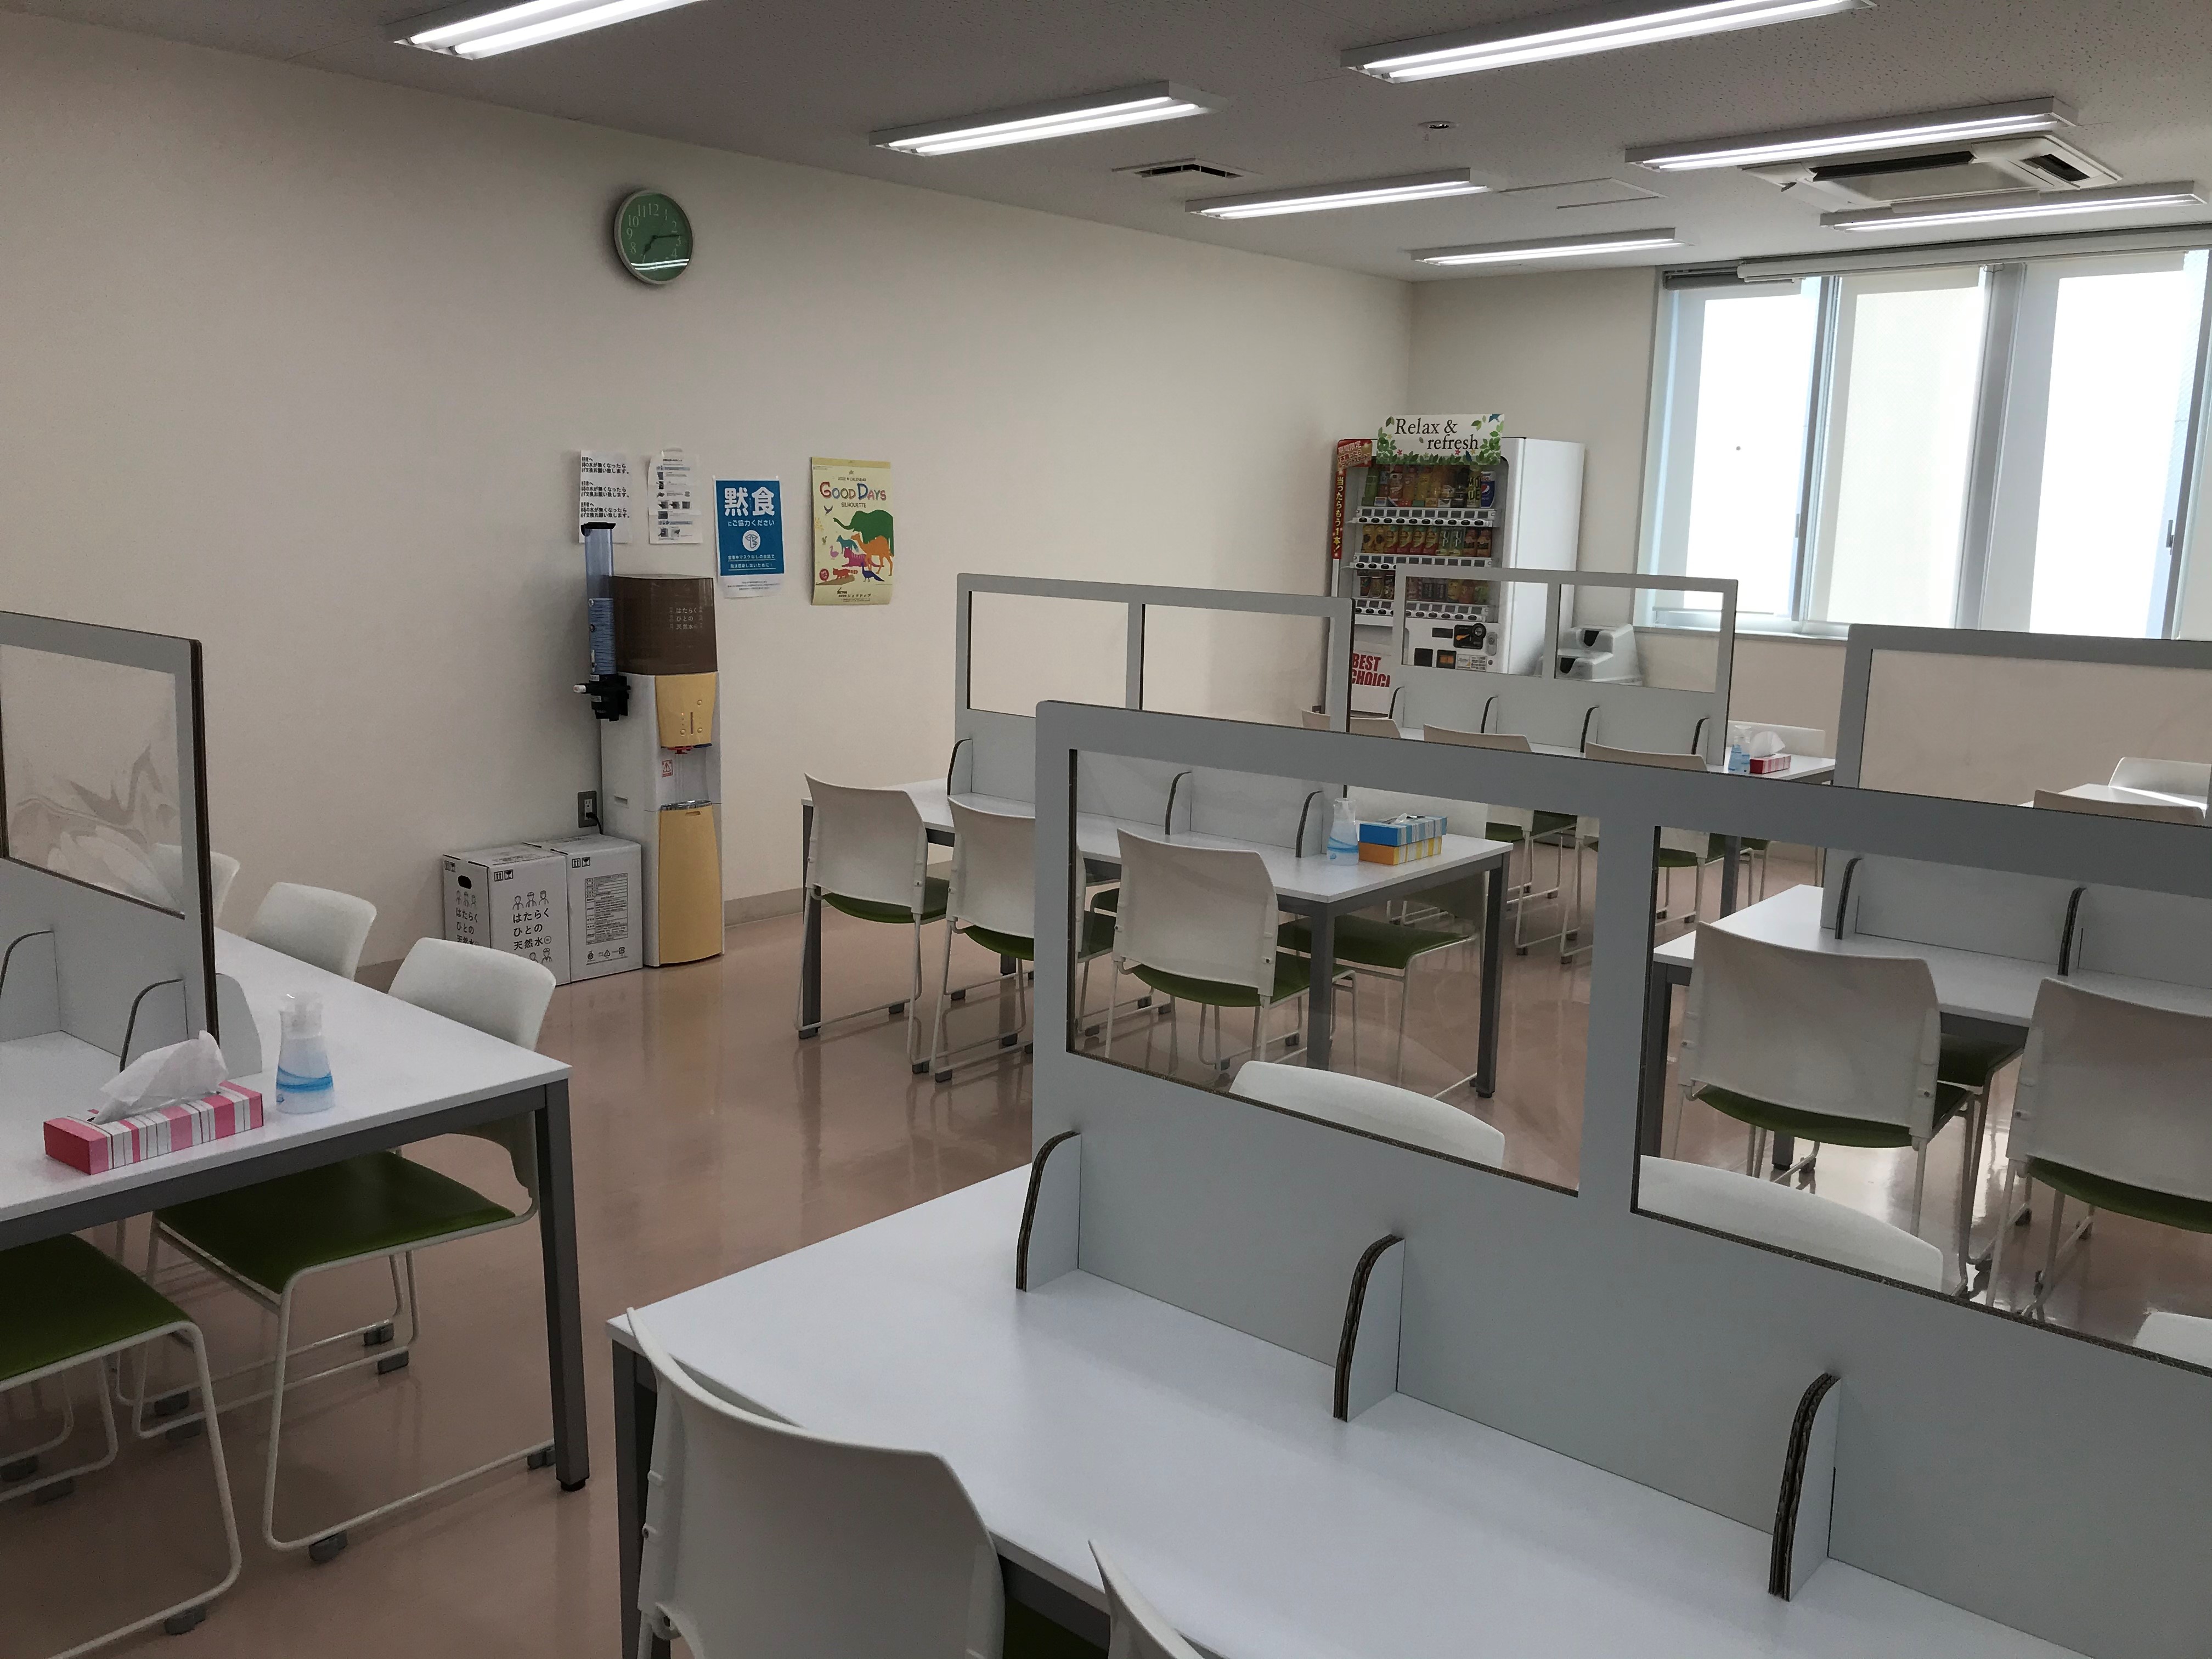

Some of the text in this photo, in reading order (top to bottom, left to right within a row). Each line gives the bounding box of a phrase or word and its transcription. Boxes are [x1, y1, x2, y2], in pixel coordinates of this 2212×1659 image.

[638, 205, 645, 217] 11
[649, 203, 659, 216] 12
[629, 215, 639, 228] 10
[1395, 417, 1458, 435] Relax &
[1427, 434, 1479, 450] refresh
[820, 481, 887, 501] GOOD DAYS
[724, 487, 775, 516] 黙食
[1352, 653, 1381, 672] BEST
[456, 907, 478, 923] はたらく
[513, 908, 549, 923] はたらく
[456, 922, 474, 934] ひとの
[514, 924, 543, 937] ひとの
[514, 937, 543, 951] 天然水
